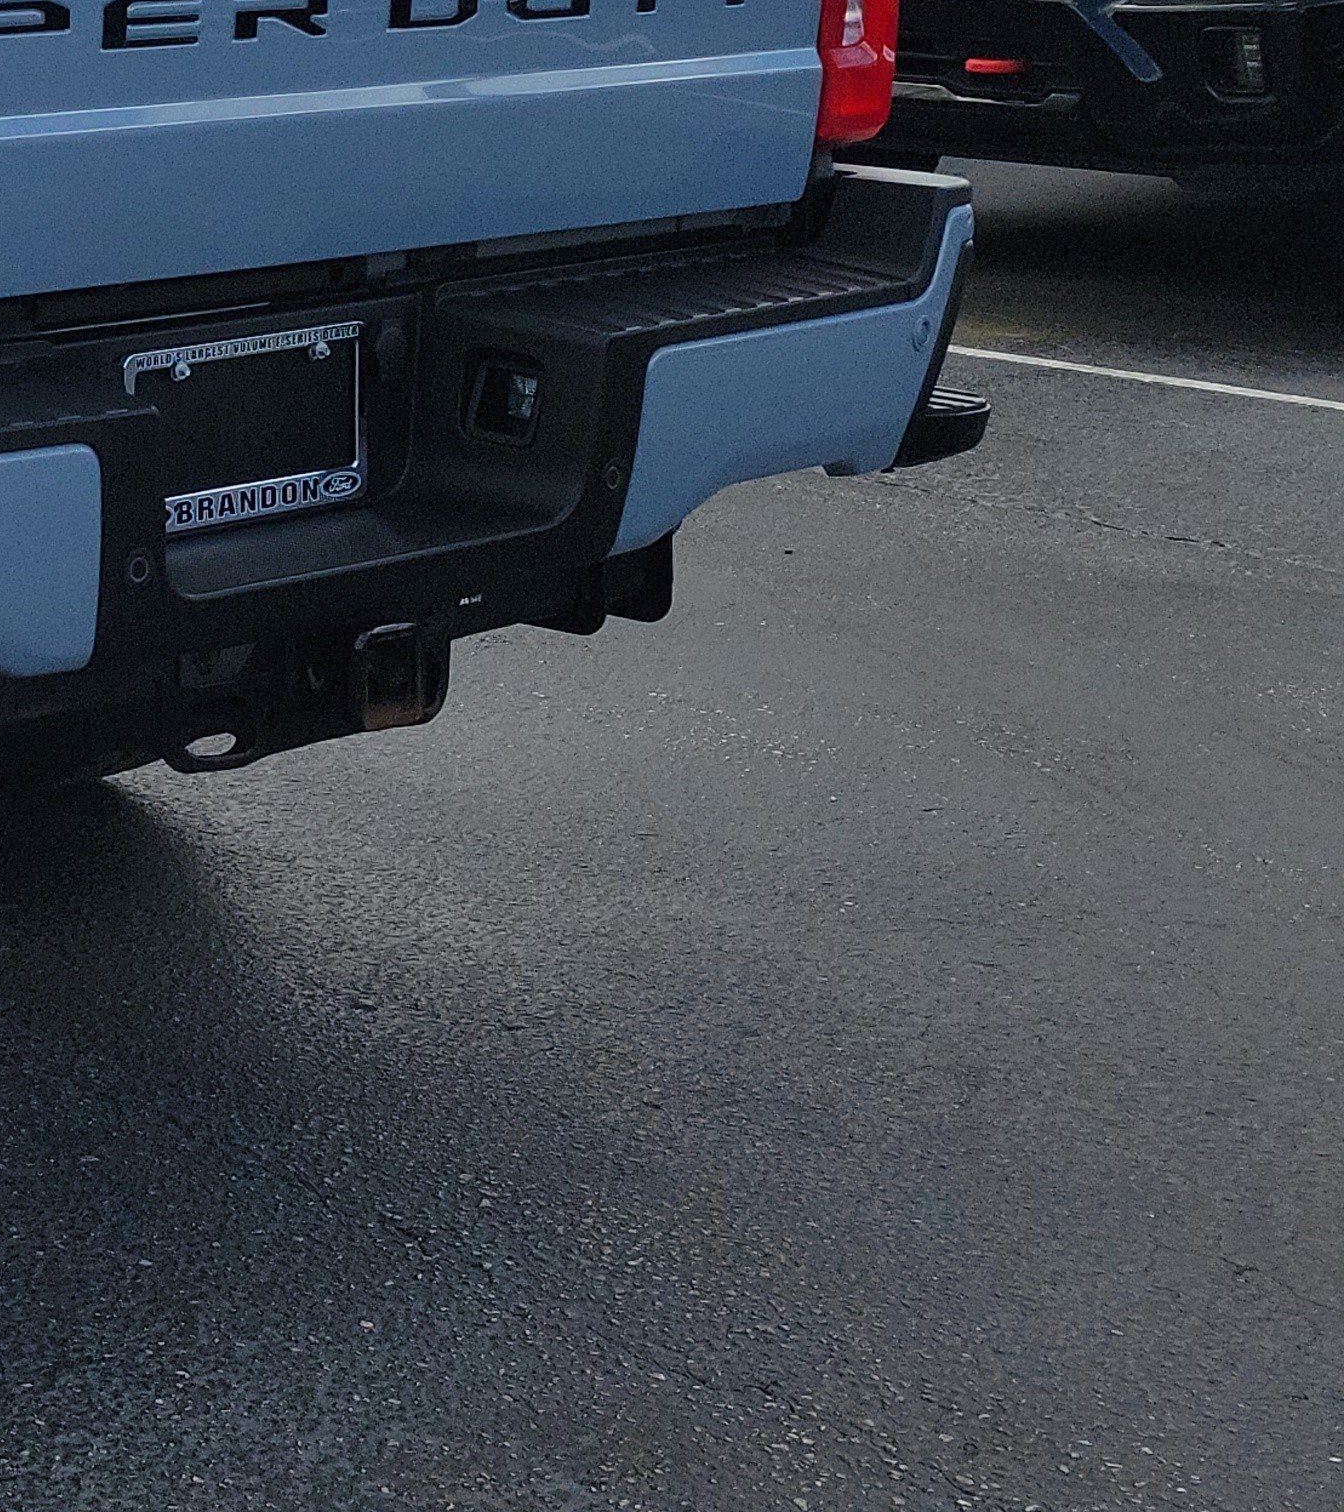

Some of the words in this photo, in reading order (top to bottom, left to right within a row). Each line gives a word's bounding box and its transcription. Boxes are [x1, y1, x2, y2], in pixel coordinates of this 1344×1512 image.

[233, 336, 272, 354] VOLUME
[175, 477, 319, 526] BRANDON
[328, 476, 353, 493] Ford
